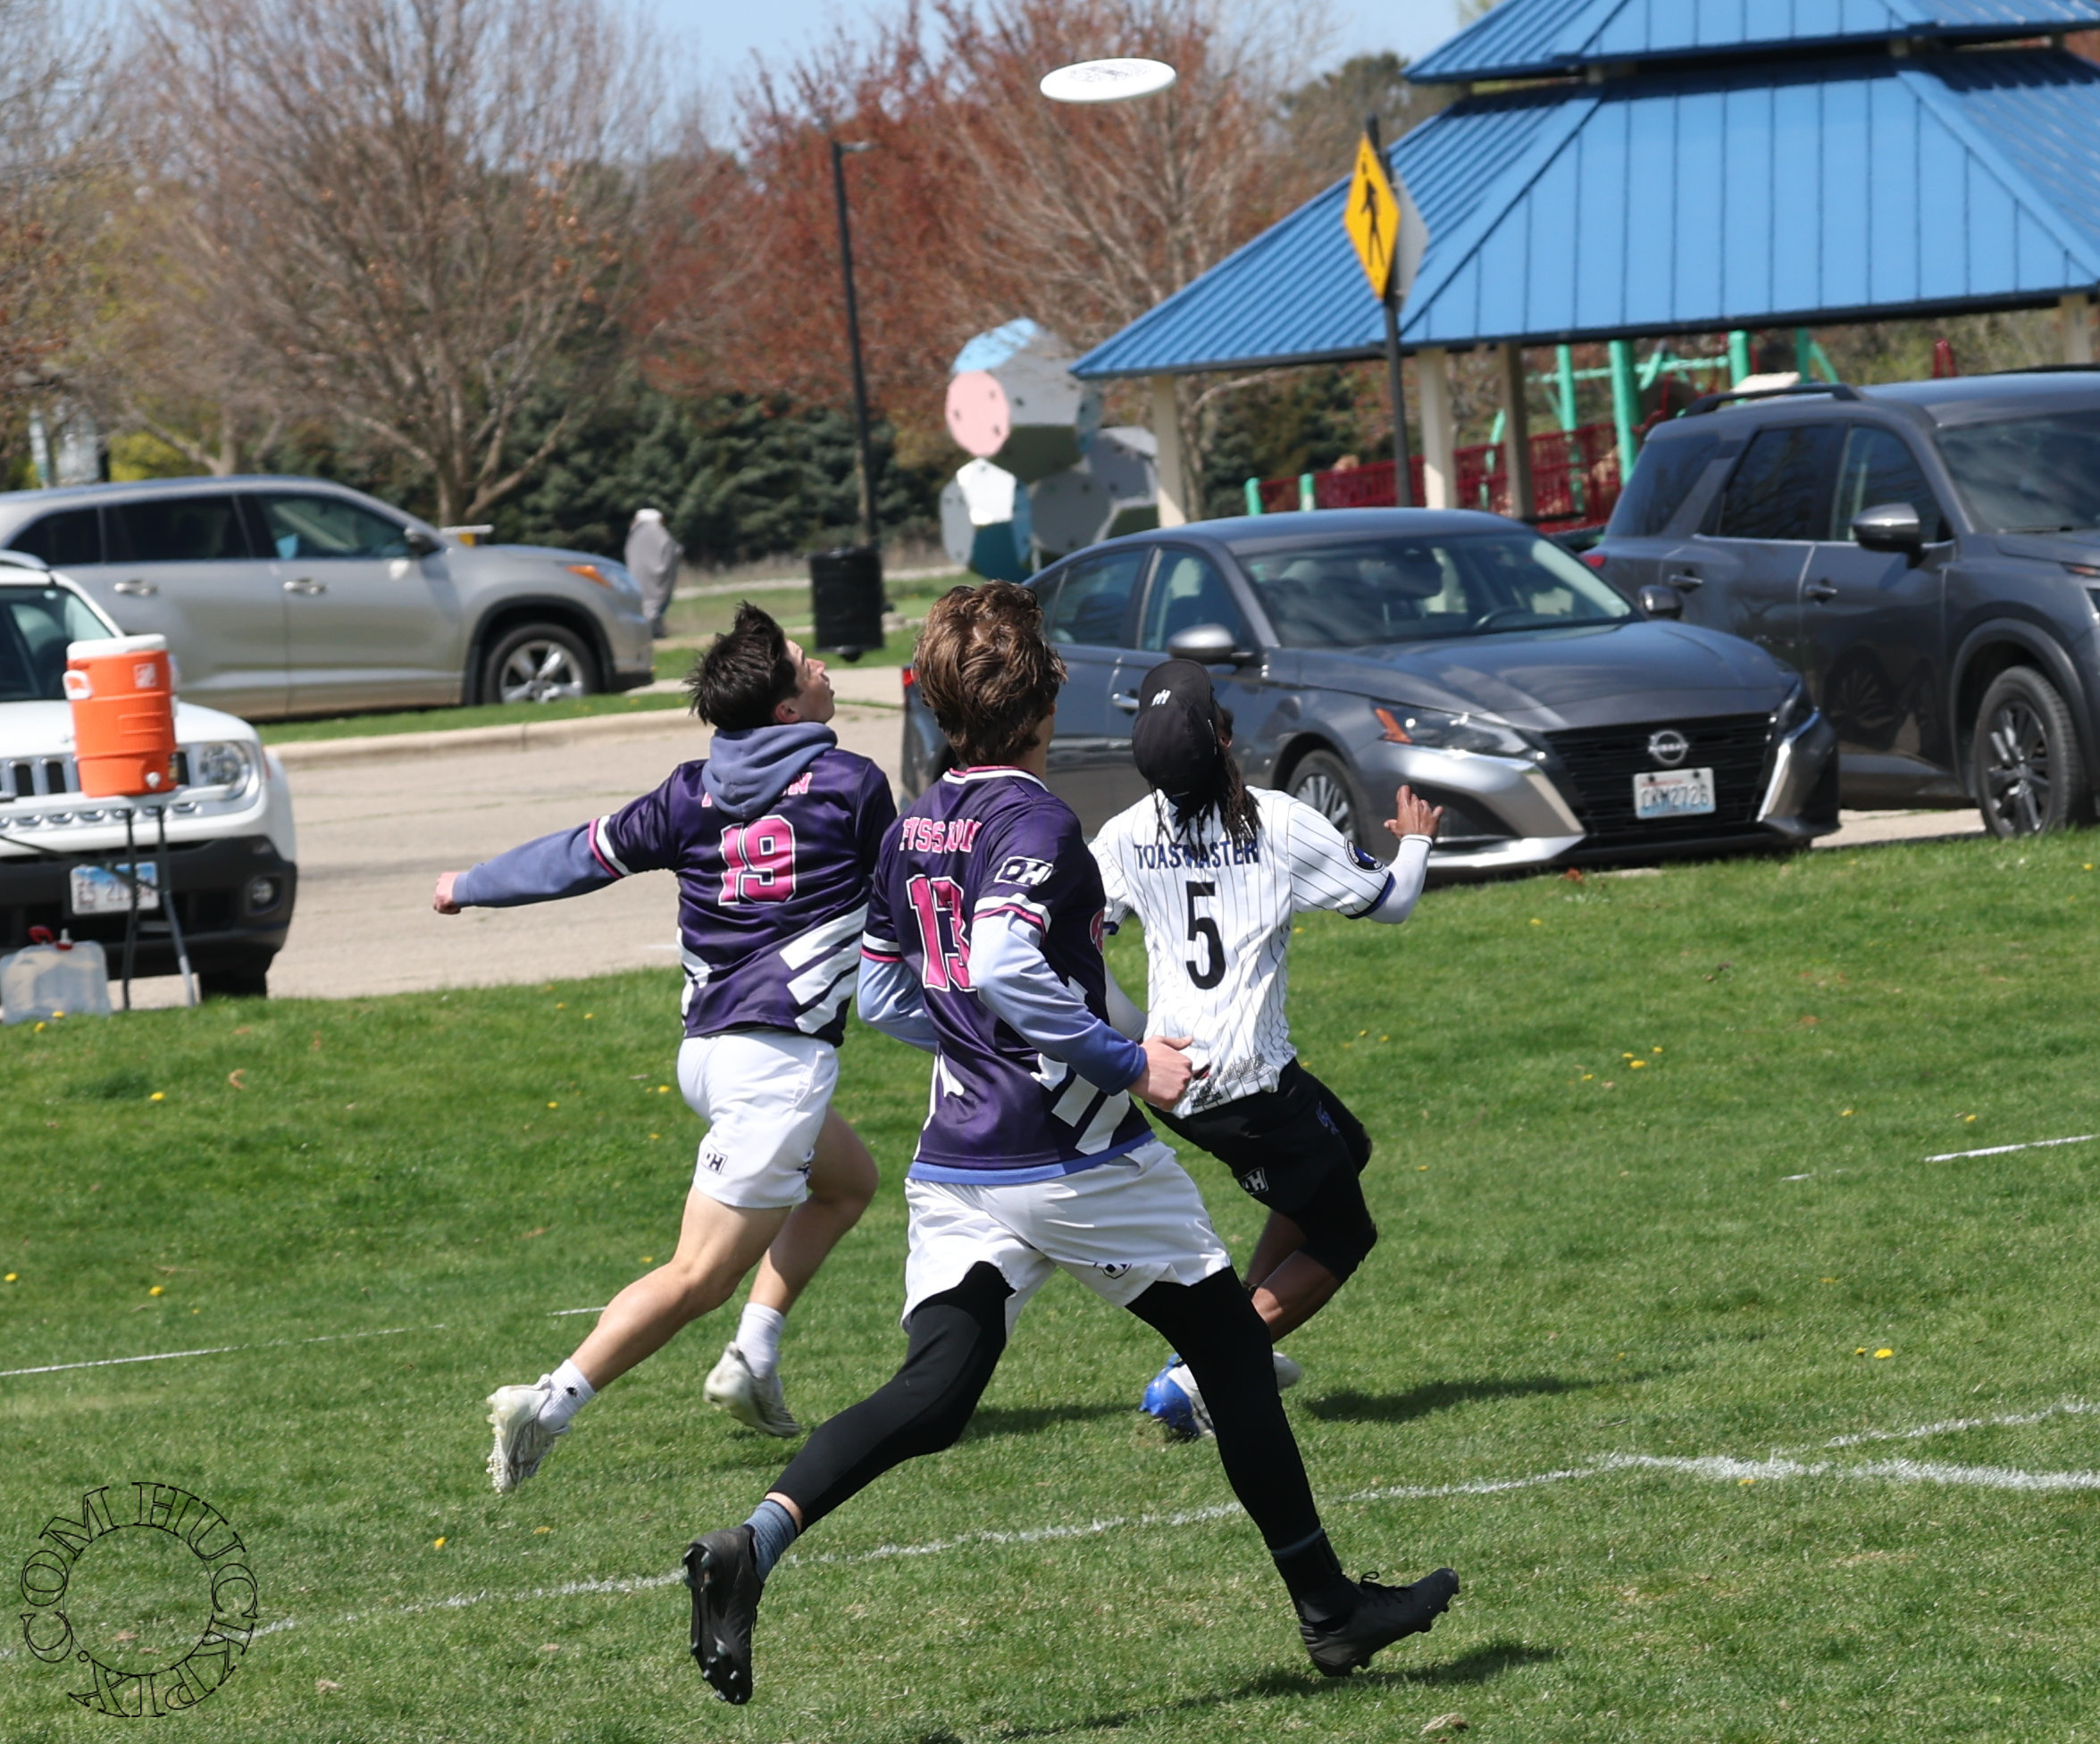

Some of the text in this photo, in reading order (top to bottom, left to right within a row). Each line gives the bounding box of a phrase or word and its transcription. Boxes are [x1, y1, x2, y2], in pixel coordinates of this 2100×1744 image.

[718, 814, 796, 906] 19
[907, 873, 977, 992] 13
[1186, 880, 1226, 990] 5
